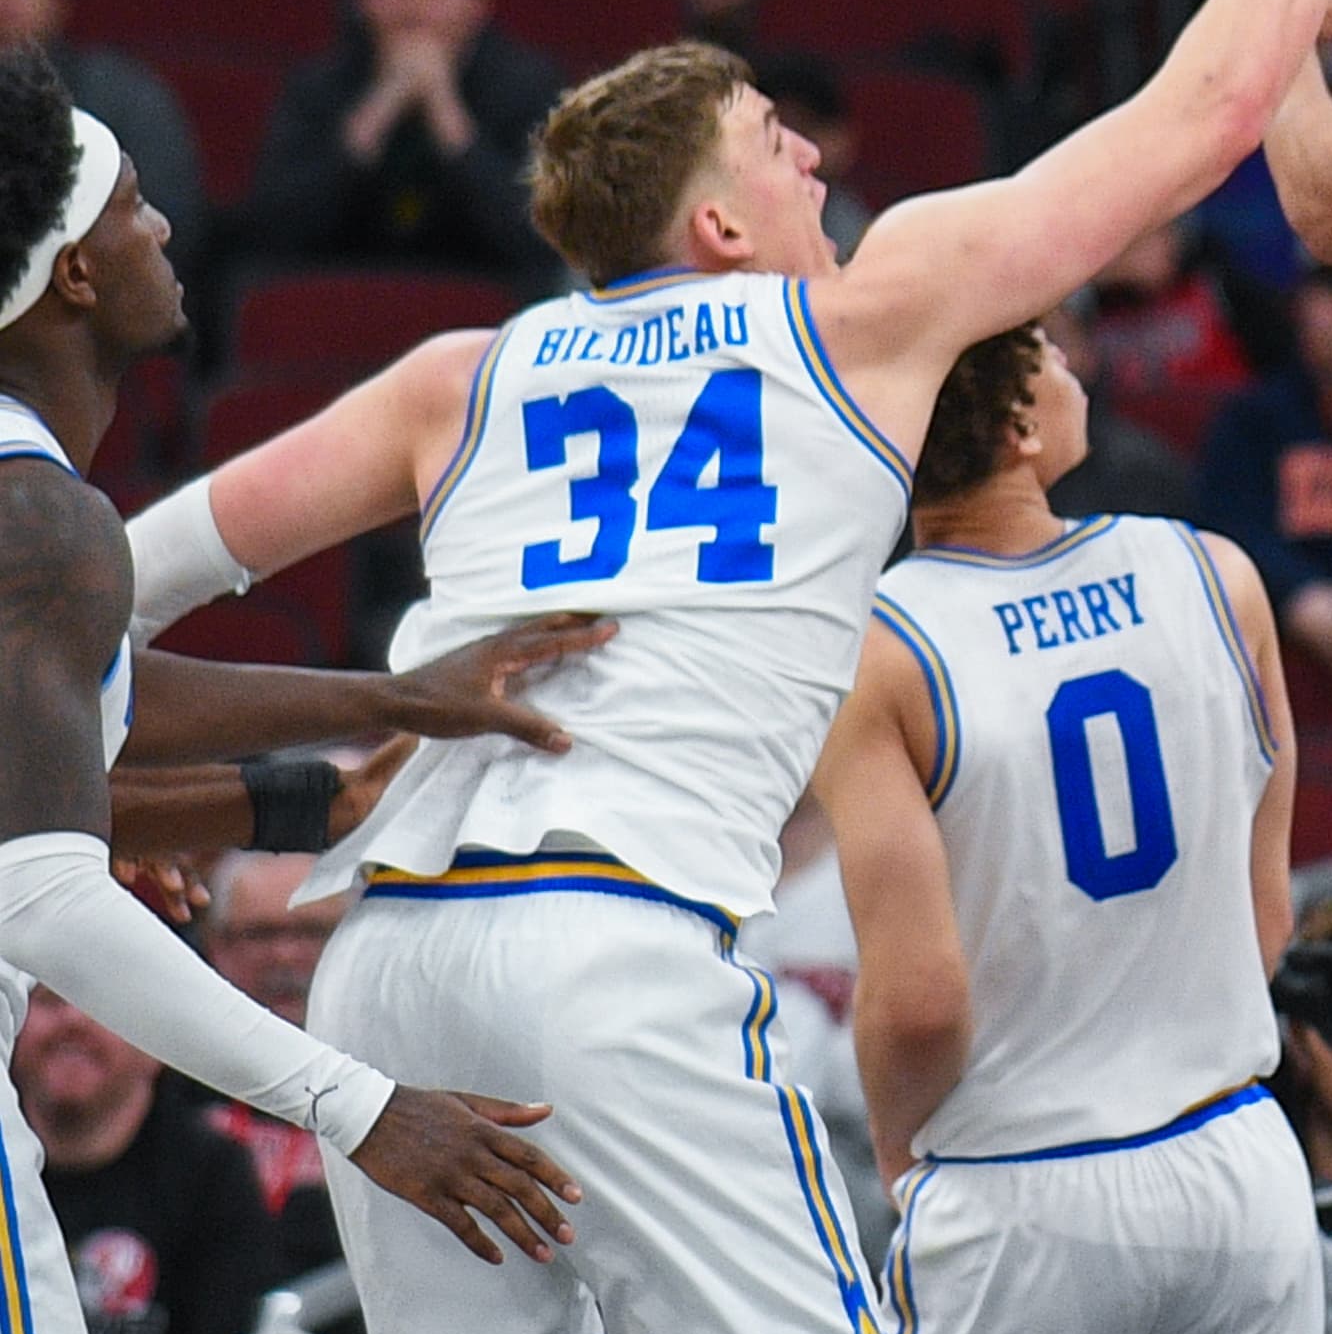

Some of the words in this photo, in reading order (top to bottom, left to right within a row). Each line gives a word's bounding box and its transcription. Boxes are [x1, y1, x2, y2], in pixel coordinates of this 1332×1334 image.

[532, 302, 749, 367] BILODEAU
[521, 367, 778, 591] 34
[992, 572, 1144, 656] PERRY
[1045, 668, 1179, 903] 0
